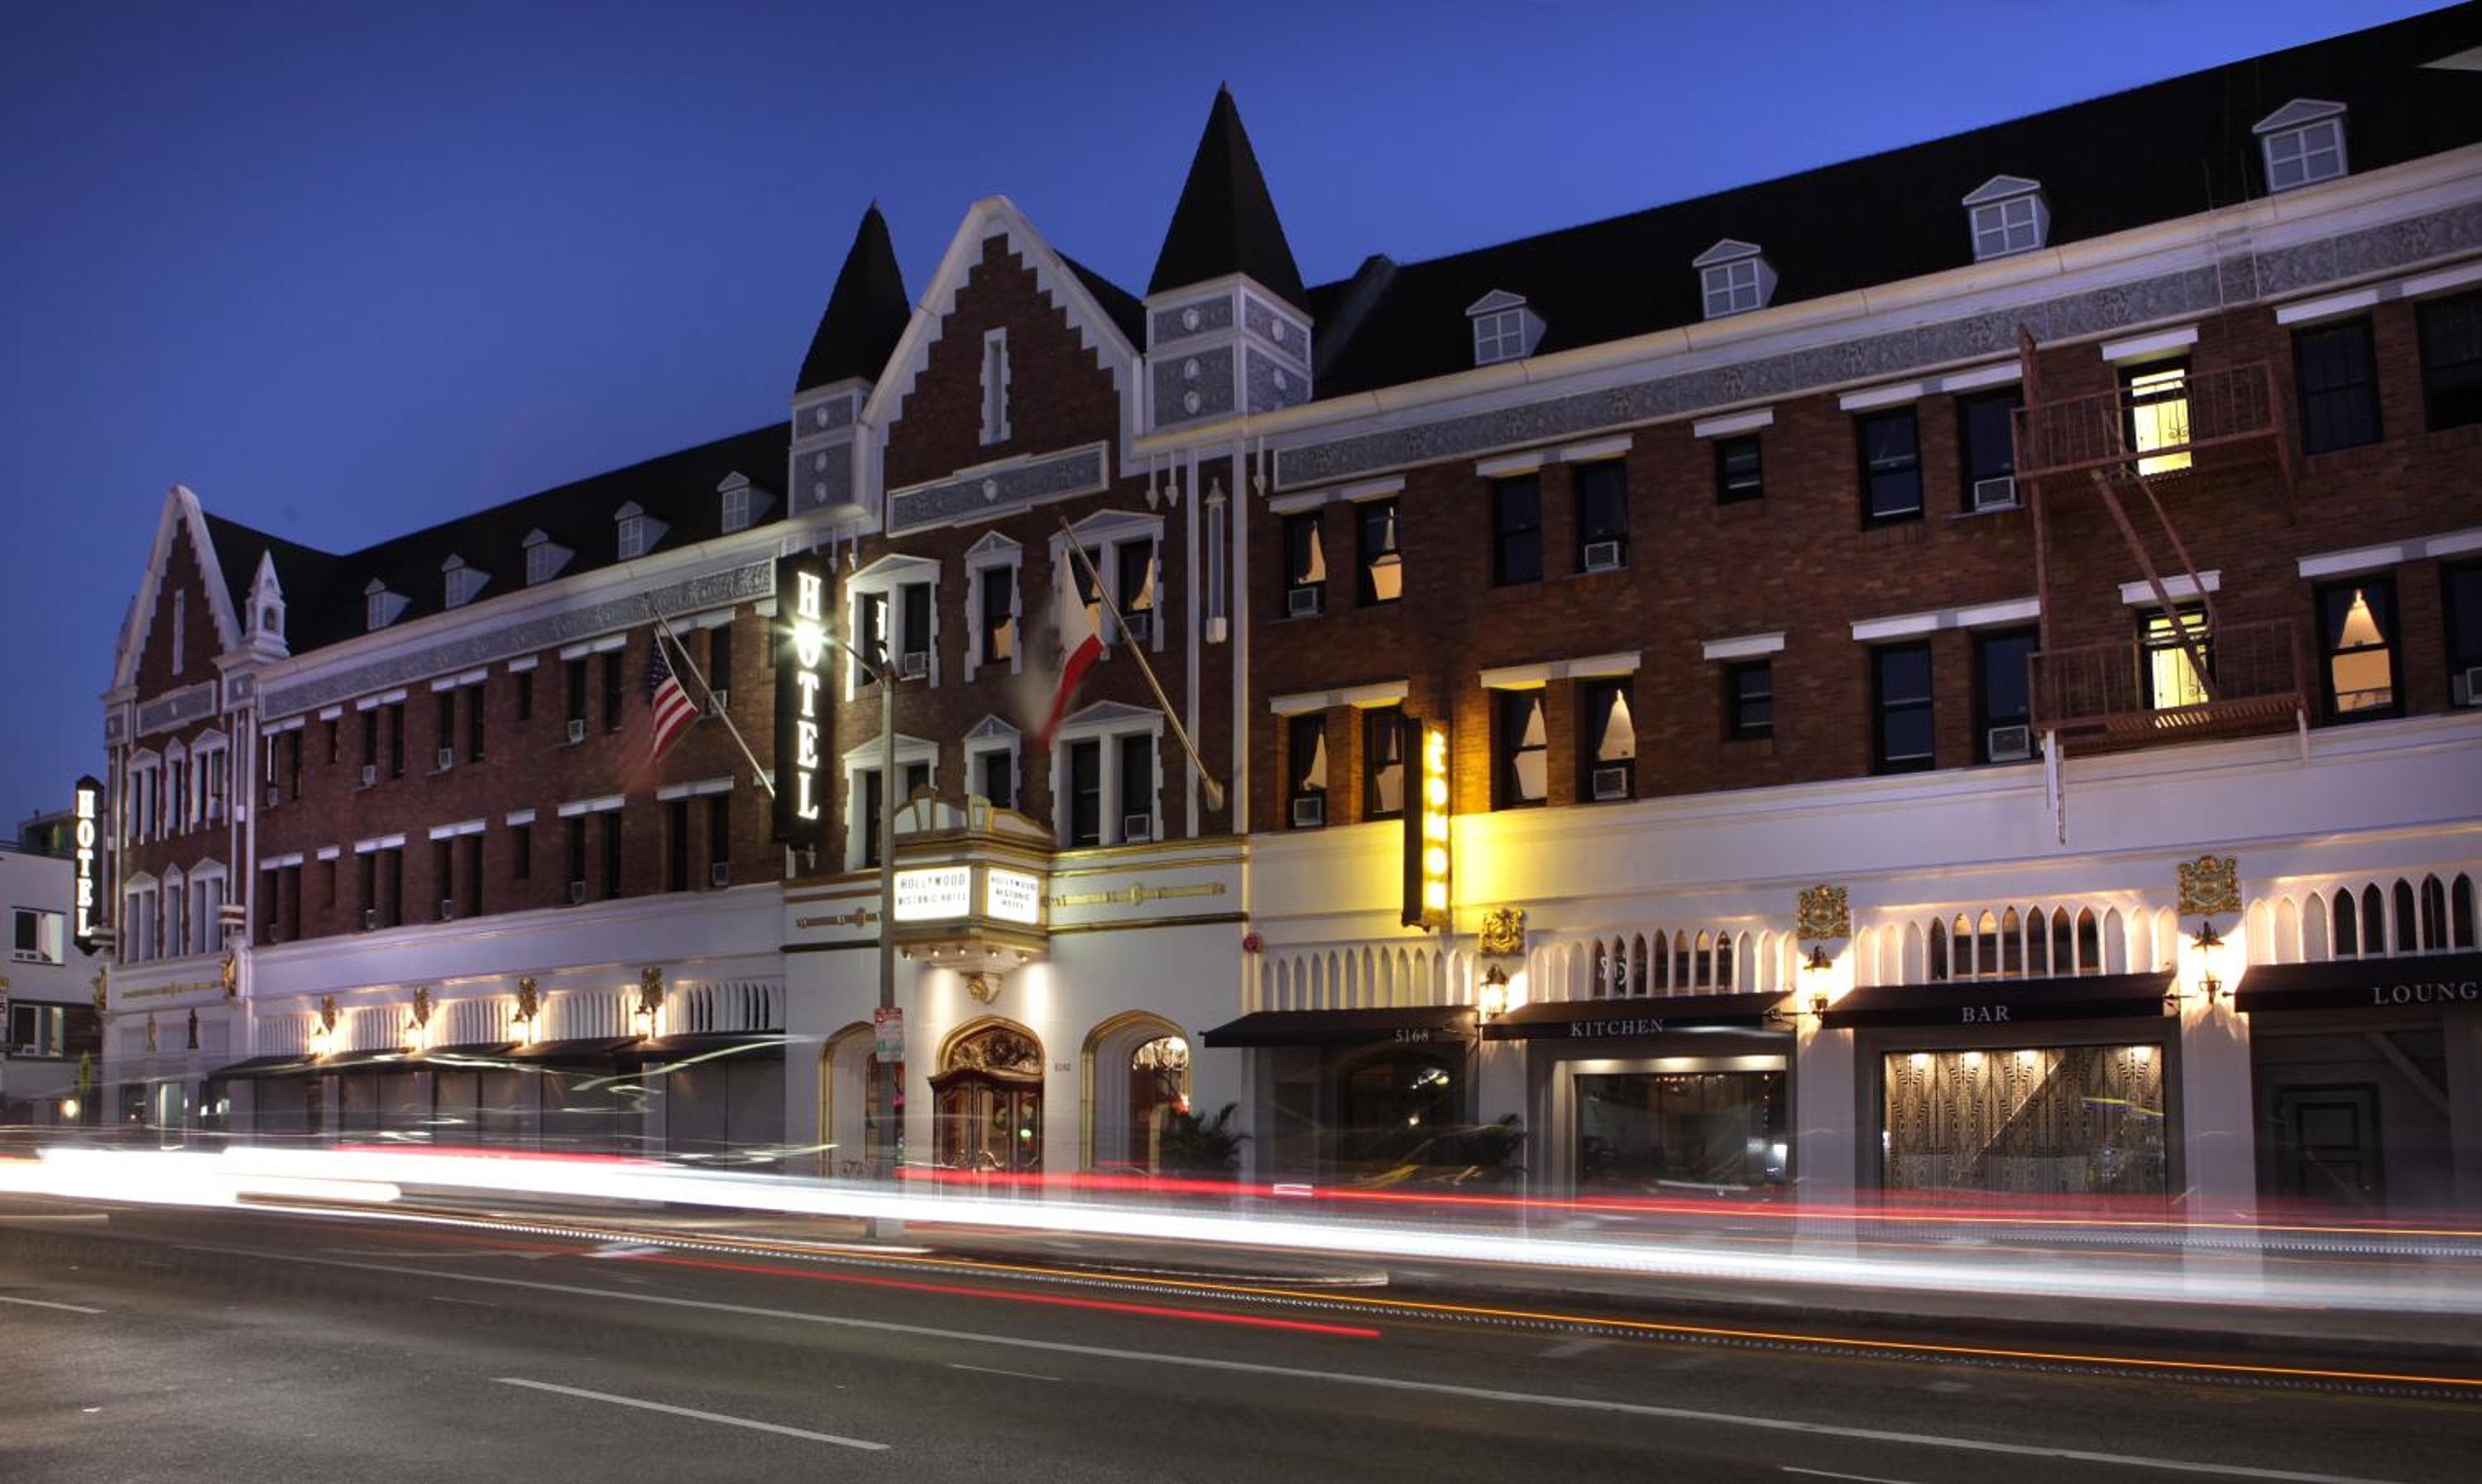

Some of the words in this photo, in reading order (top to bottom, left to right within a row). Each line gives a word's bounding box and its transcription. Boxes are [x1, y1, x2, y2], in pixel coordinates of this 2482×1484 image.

[797, 571, 822, 821] HOTEL
[77, 789, 95, 936] HOTEL
[900, 874, 966, 889] HOLLYWOOD
[1962, 1005, 2010, 1023] BAR
[1394, 1027, 1430, 1044] 5168
[1571, 1018, 1665, 1037] KITCHEN
